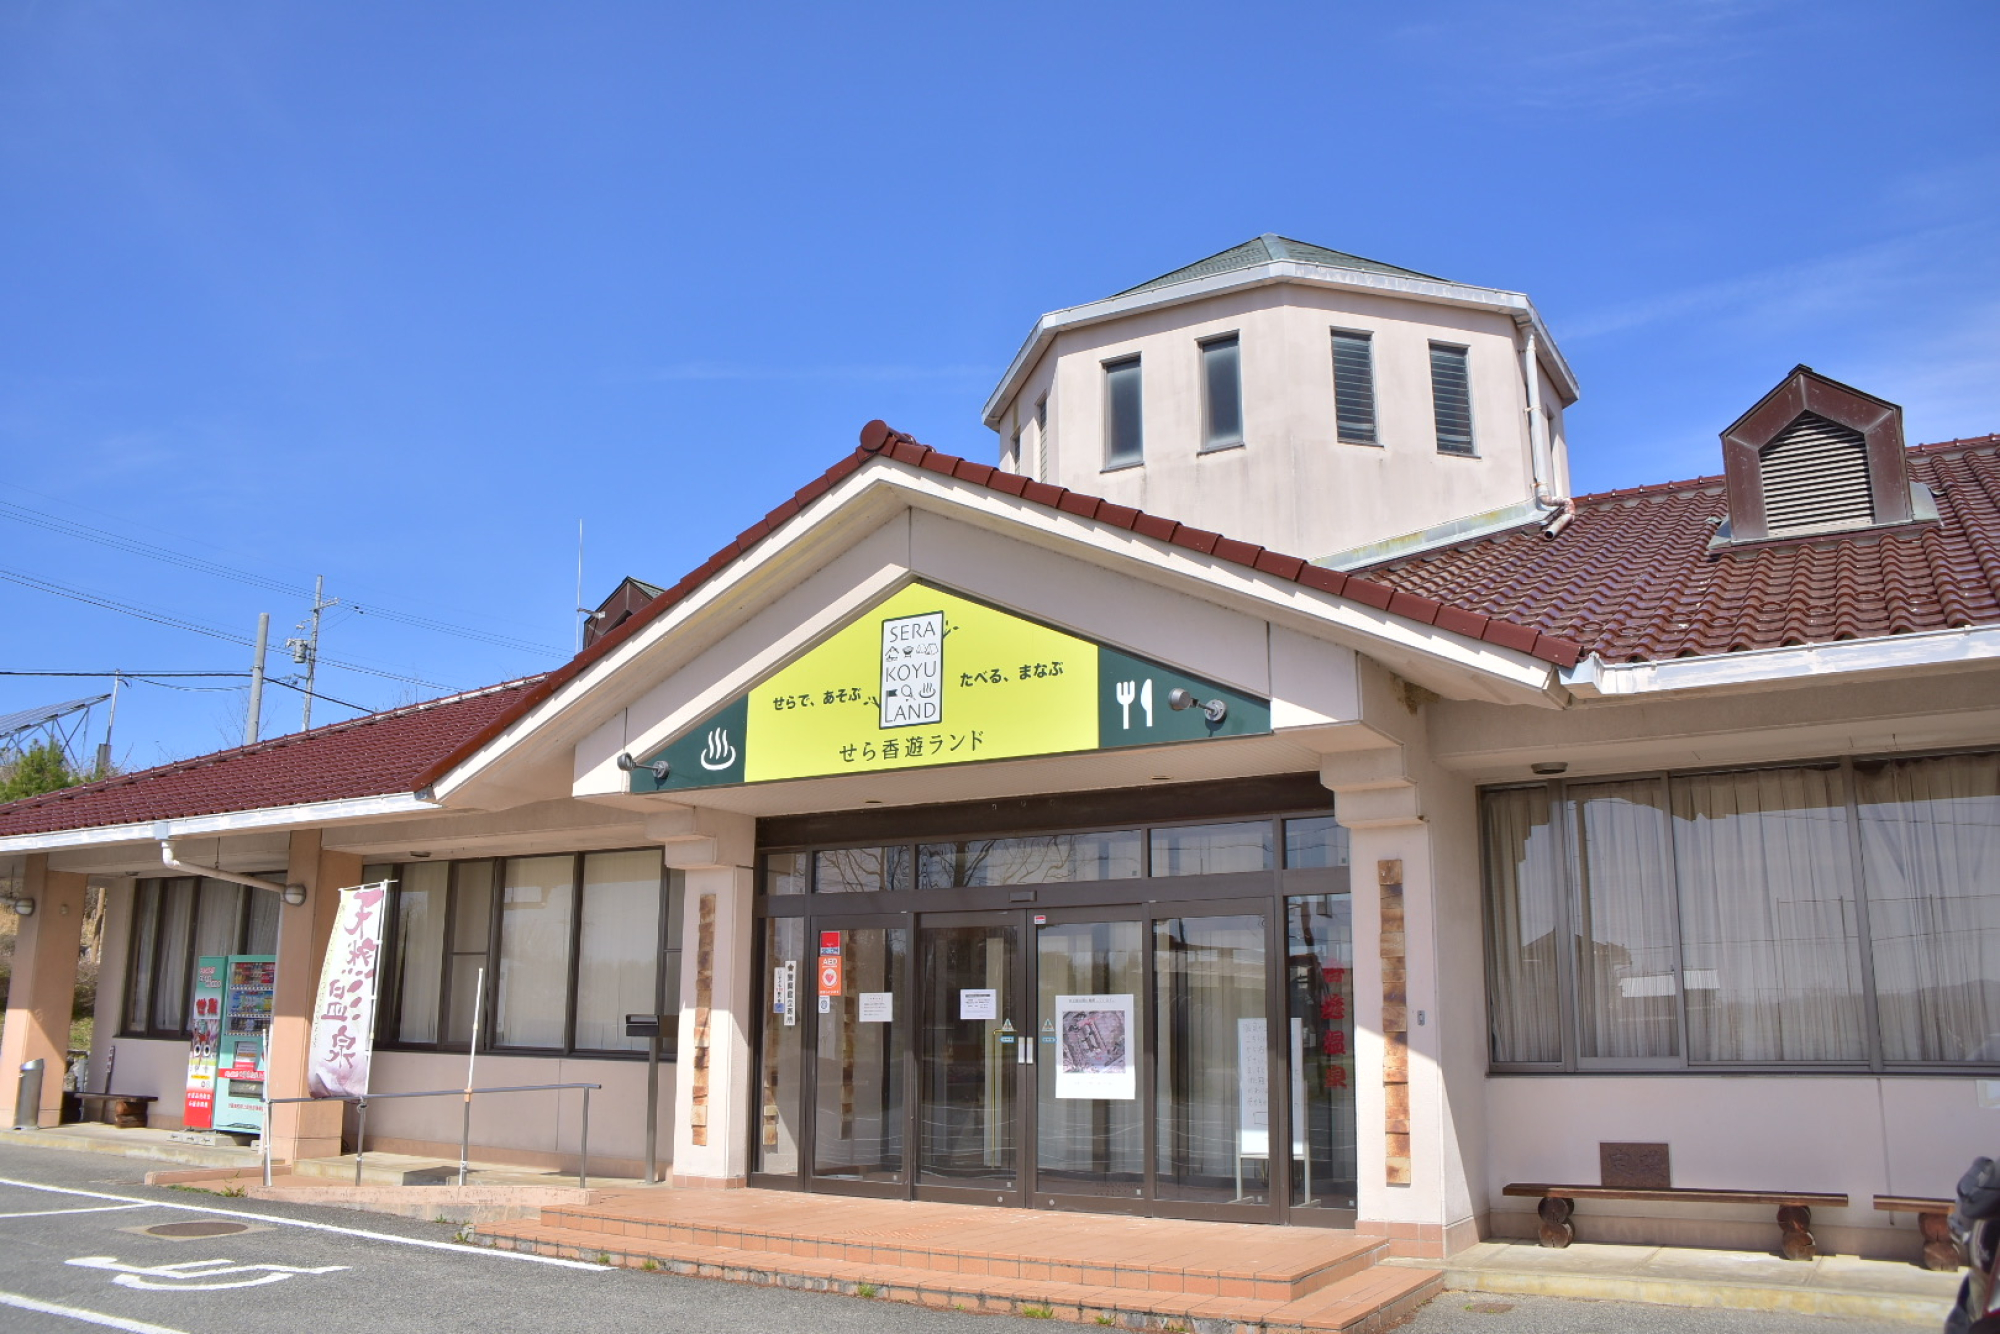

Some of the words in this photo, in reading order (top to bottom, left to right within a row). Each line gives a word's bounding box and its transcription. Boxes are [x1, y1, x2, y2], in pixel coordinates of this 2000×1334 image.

[890, 621, 936, 642] SERA
[885, 660, 937, 682] KOYU
[960, 661, 1063, 688] たべる、まなぶ
[773, 687, 862, 711] せらで、あそぶ
[885, 695, 937, 722] LAND
[839, 730, 984, 762] せら香遊ランド
[823, 958, 838, 966] AED
[321, 888, 384, 1069] 天然温泉
